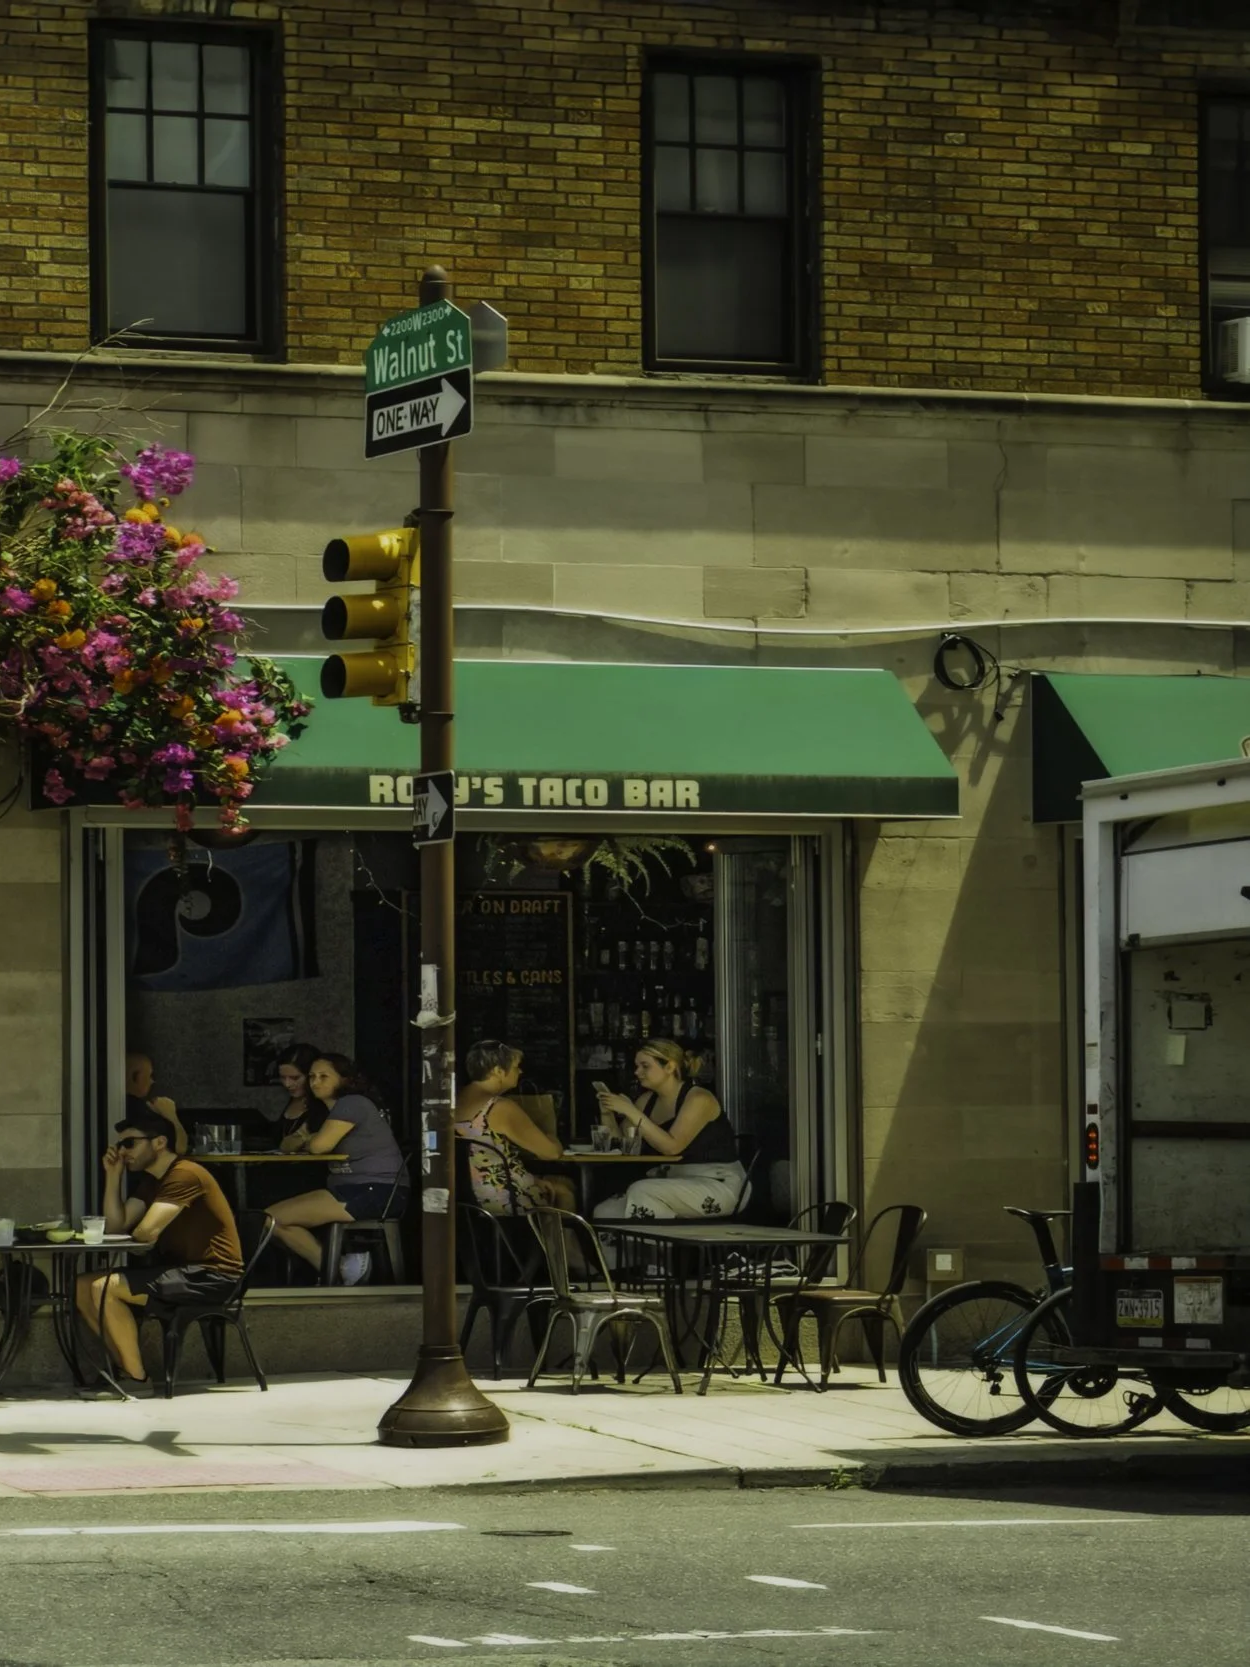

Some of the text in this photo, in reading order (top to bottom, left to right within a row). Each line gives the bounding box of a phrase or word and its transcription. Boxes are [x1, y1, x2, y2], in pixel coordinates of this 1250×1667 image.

[374, 329, 464, 385] Walnut St
[376, 397, 439, 436] ONE WAY
[369, 774, 700, 808] ROY'S TACO BAR
[480, 899, 505, 914] ON
[510, 899, 561, 914] DRAFT
[506, 970, 516, 985] &
[520, 970, 562, 985] CANS
